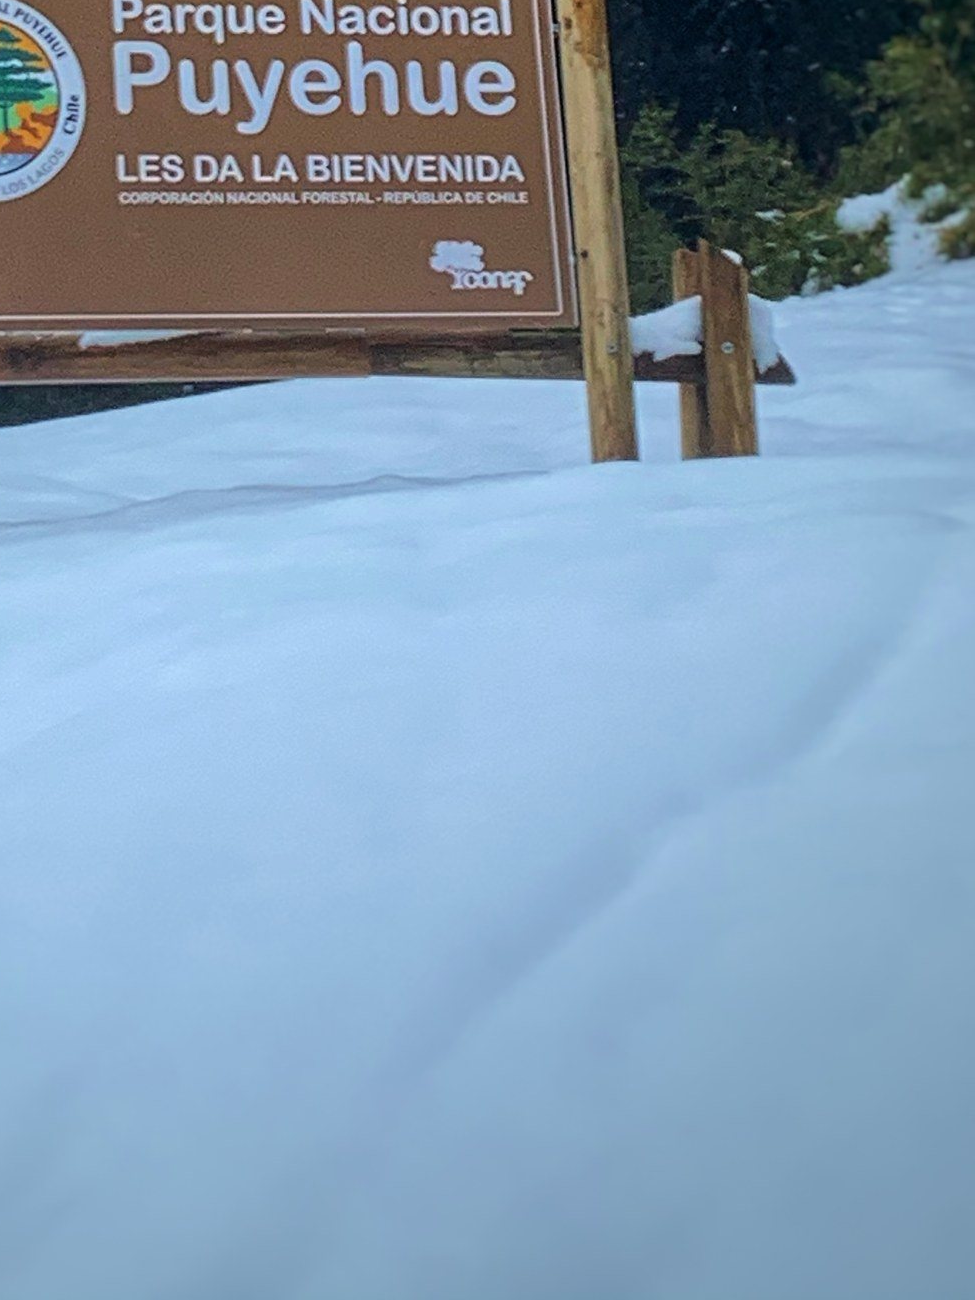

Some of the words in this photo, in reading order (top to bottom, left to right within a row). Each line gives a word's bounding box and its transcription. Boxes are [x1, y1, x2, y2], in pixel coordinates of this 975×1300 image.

[113, 39, 517, 135] Puyehue
[1, 176, 26, 197] LOS
[27, 148, 67, 186] LAGOS
[115, 153, 186, 184] LES
[193, 154, 245, 184] DA
[252, 154, 300, 184] LA
[307, 153, 525, 184] BIENVENIDA
[118, 188, 225, 205] CORPORACIÓN
[226, 190, 300, 205] NACIONAL
[302, 190, 375, 205] FORESTAL
[383, 188, 463, 205] REPÚBLICA
[465, 191, 484, 205] DE
[486, 191, 529, 205] CHILE
